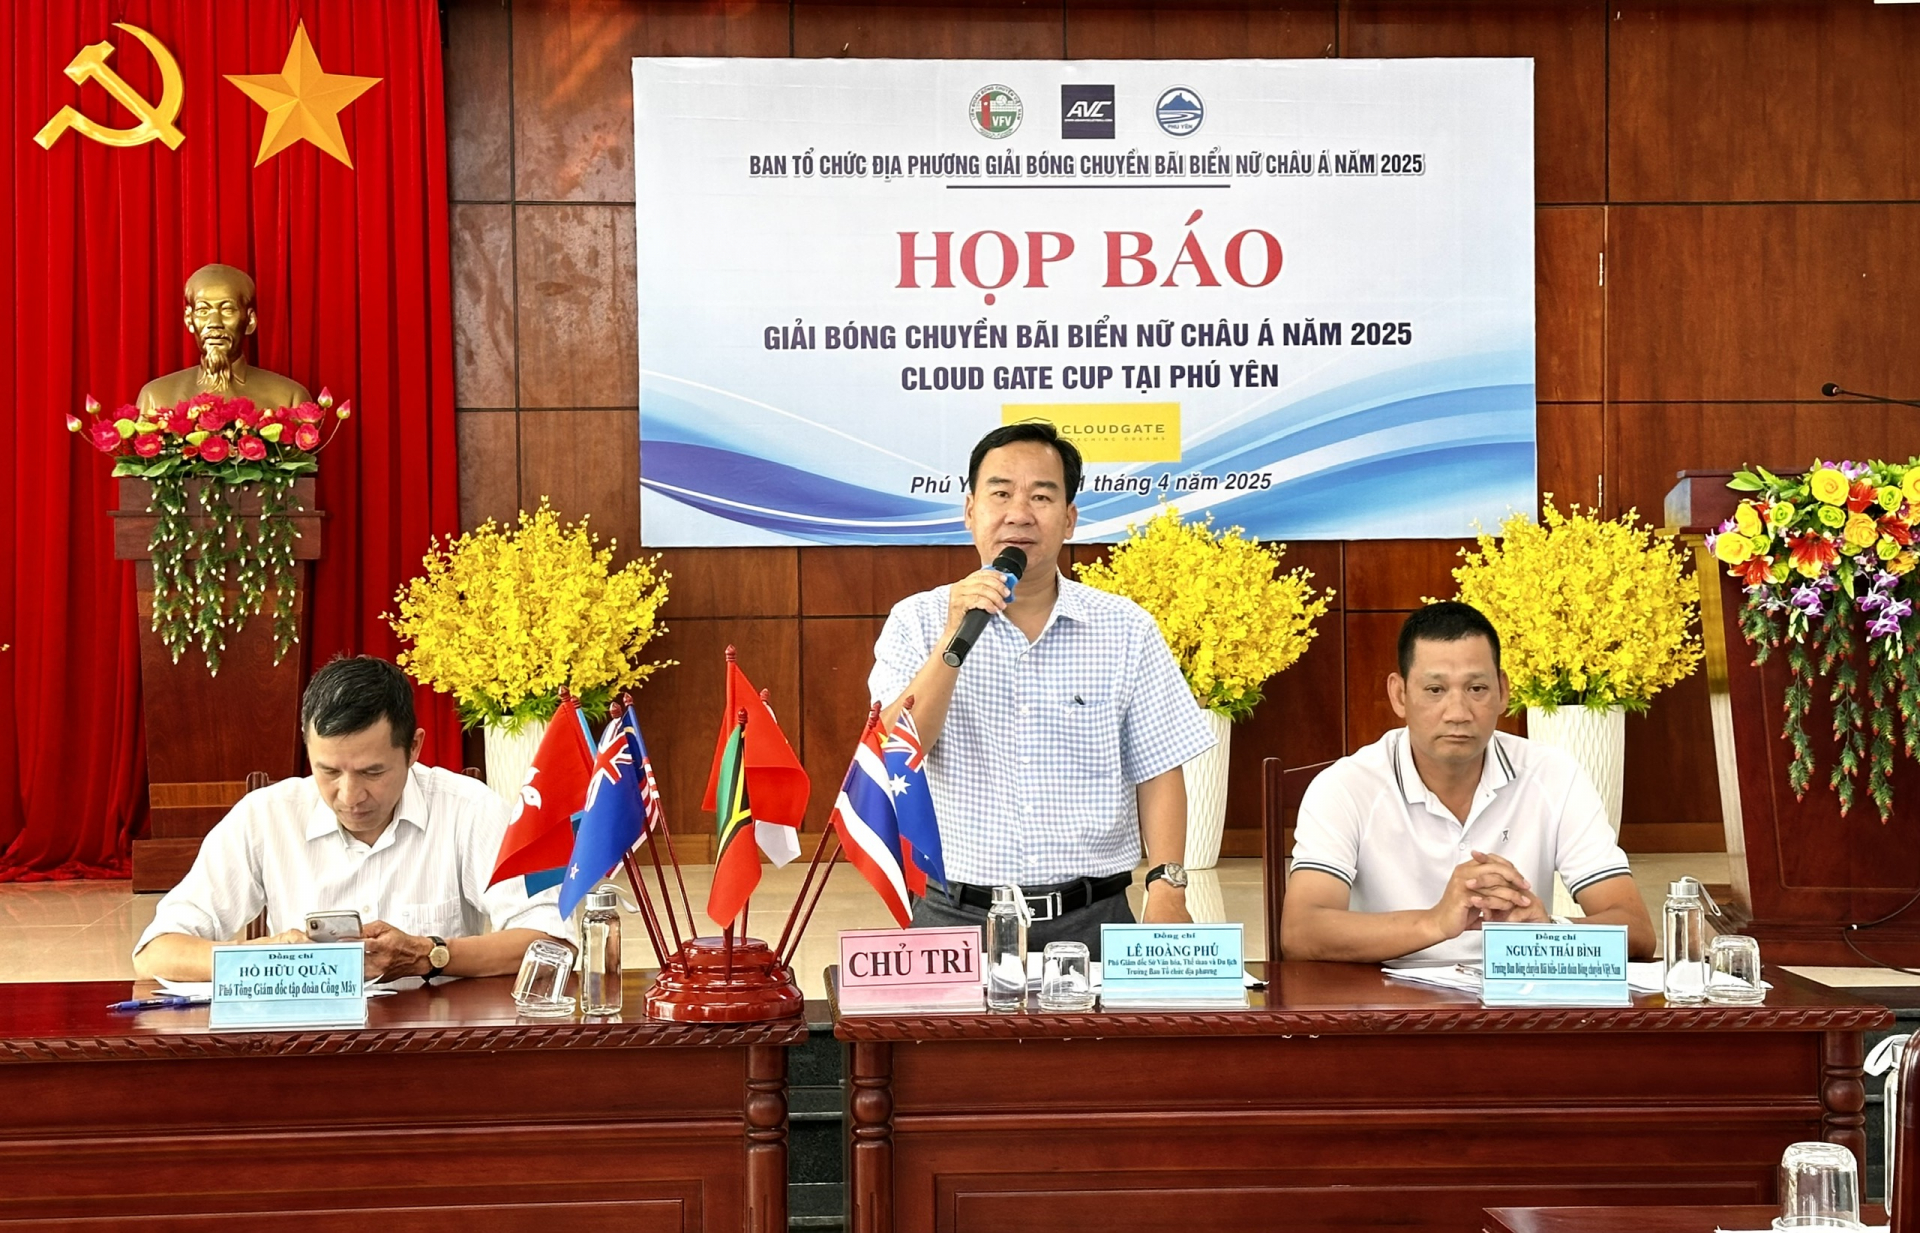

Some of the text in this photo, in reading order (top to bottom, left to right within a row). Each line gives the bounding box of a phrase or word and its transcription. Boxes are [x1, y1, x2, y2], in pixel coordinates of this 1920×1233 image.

[1066, 101, 1112, 117] AVC
[992, 116, 1012, 126] VFV
[751, 147, 1422, 179] BAN TỔ CHỨC ĐỊA PHƯƠNG GIẢI BÓNG CHUYỀN BÃI BIỂN NỮ CHÂU Á NĂM 2025
[896, 209, 1283, 305] HỌP BÁO
[765, 315, 1411, 349] GIẢI BÓNG CHUYỀN BÃI BIỂN NỮ CHÂU Á NĂM 2025
[902, 360, 1278, 393] CLOUD GATE CUP TẠI PHÚ YÊN
[1062, 424, 1165, 434] CLOUDGATE
[911, 475, 951, 493] Phú
[1094, 474, 1151, 495] tháng
[1158, 474, 1169, 491] 4
[1176, 473, 1218, 491] năm
[1224, 473, 1272, 490] 2025
[1127, 942, 1219, 956] LÊ HOÀNG PHÚ
[1506, 942, 1601, 957] NGUYỄN THÁI BÌNH
[849, 941, 973, 977] CHỦ TRÌ
[264, 963, 294, 977] HỮU
[298, 962, 338, 978] QUÂN
[253, 982, 274, 995] Giám
